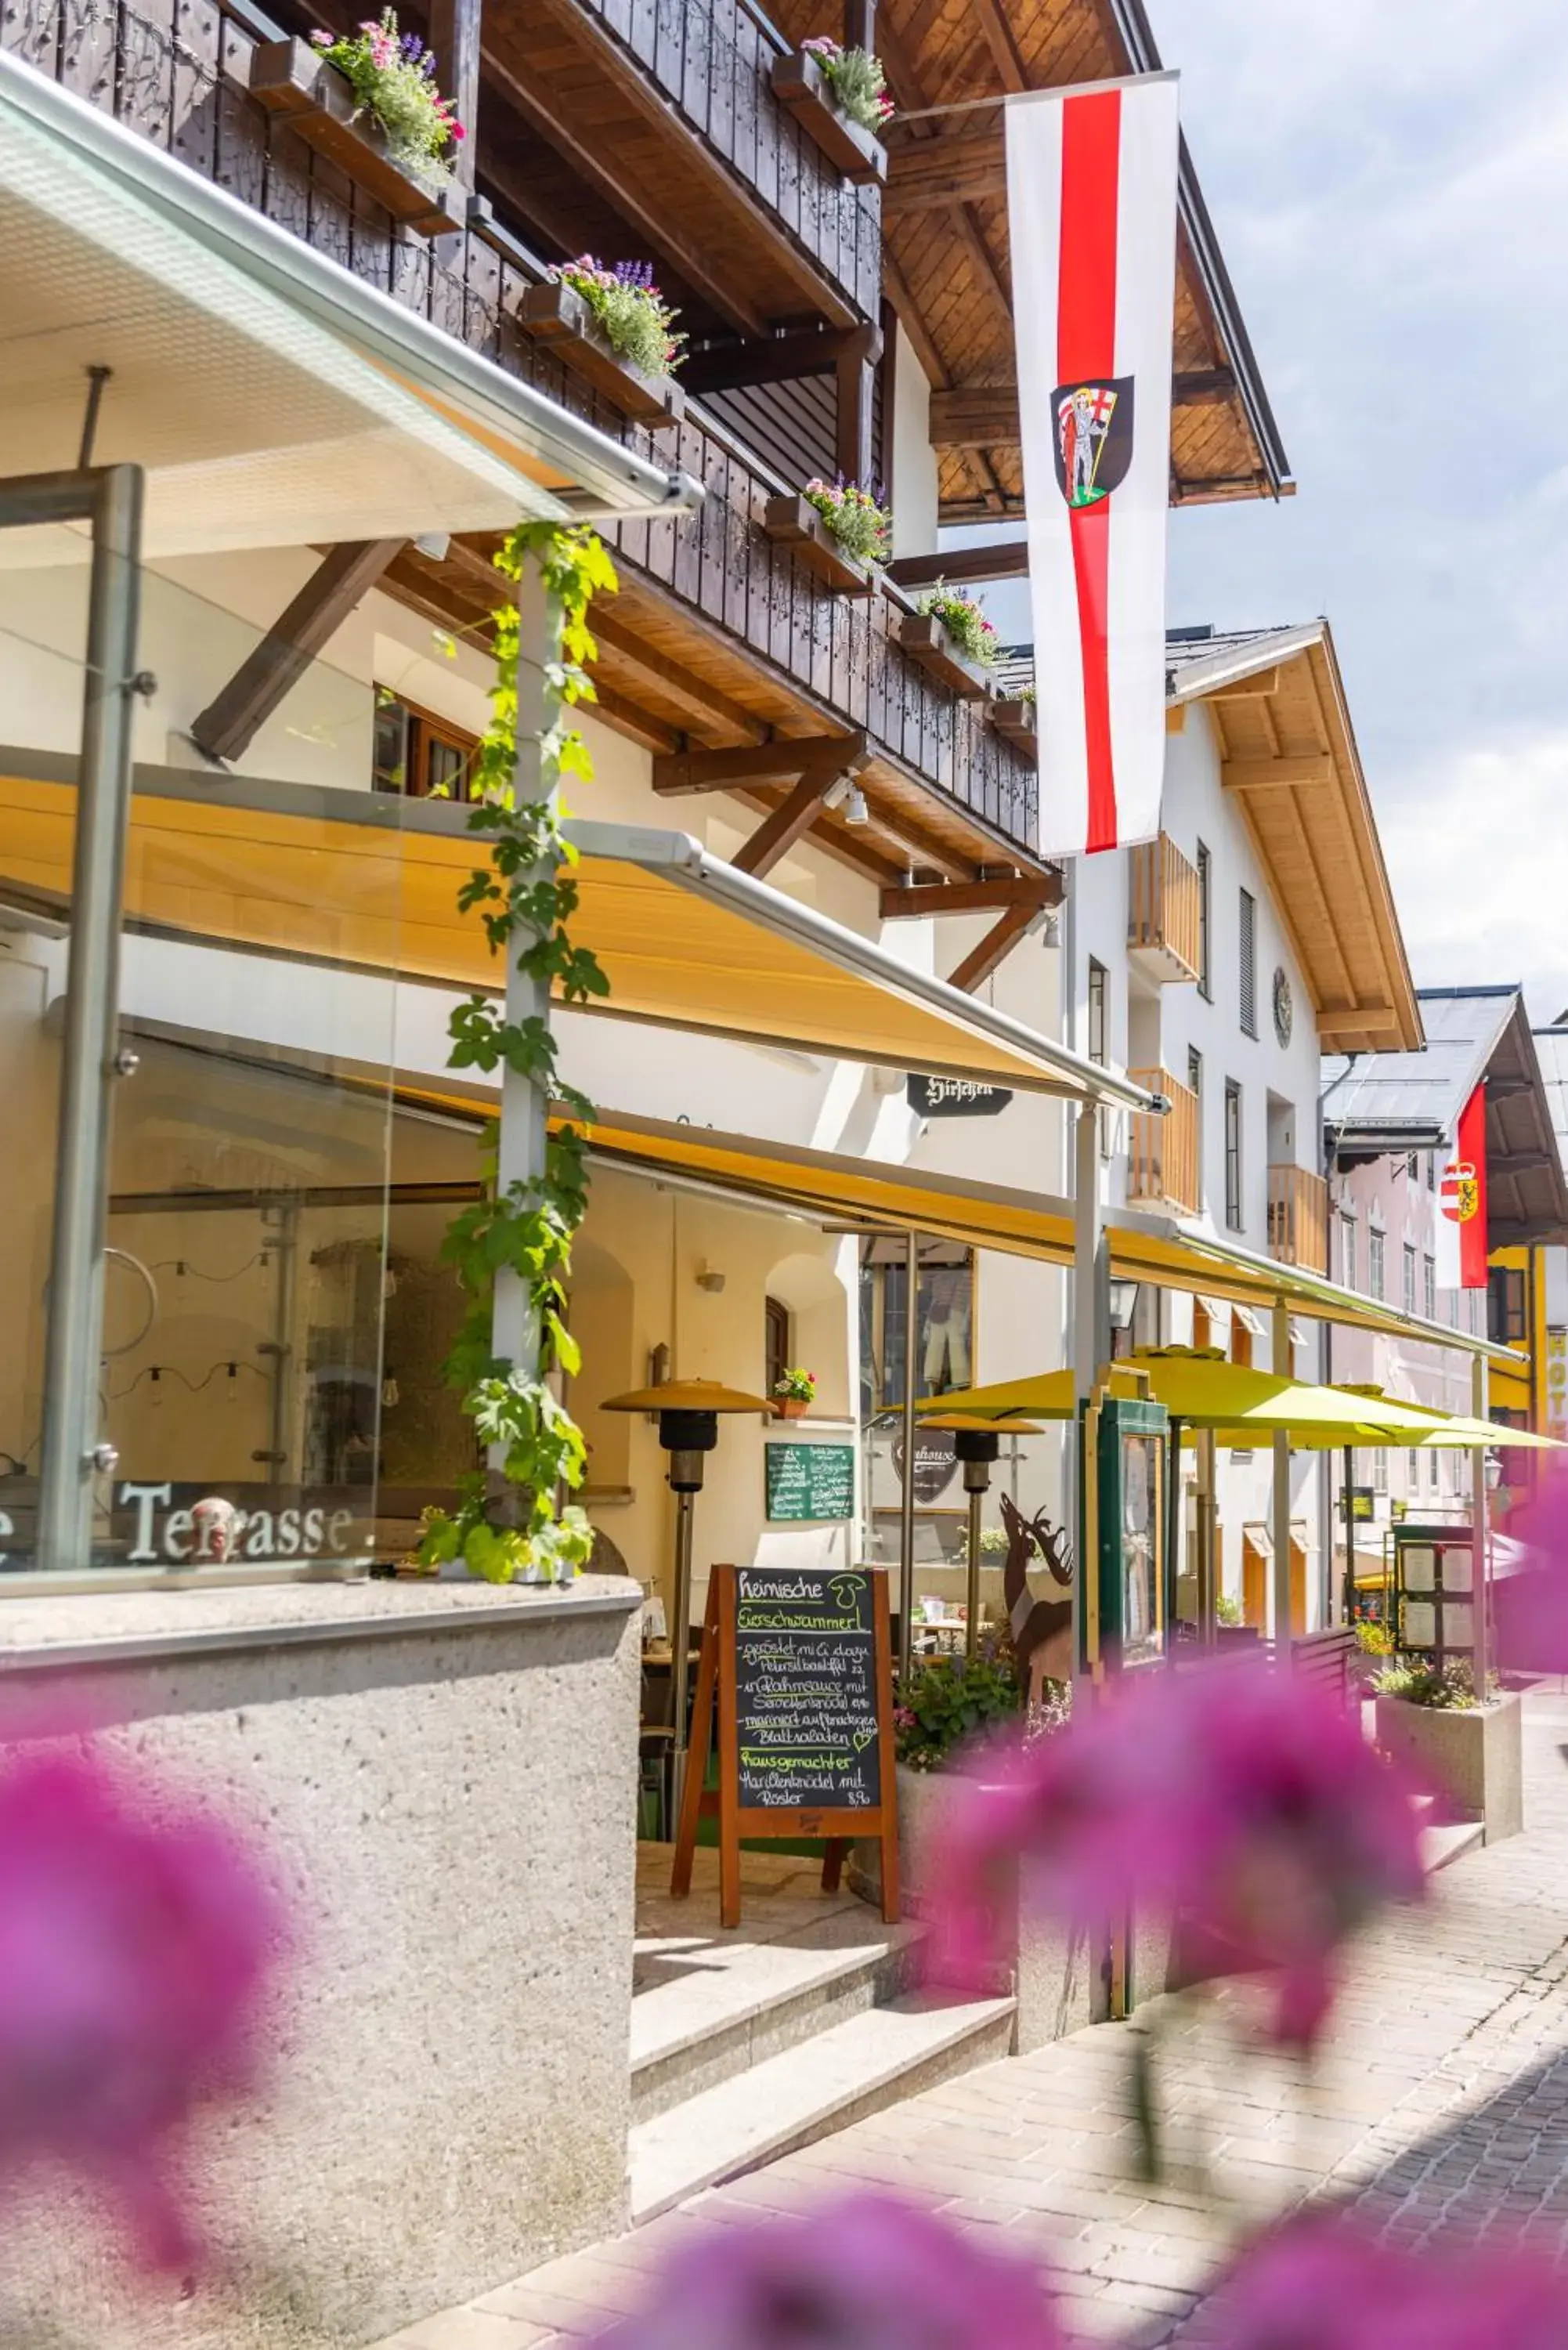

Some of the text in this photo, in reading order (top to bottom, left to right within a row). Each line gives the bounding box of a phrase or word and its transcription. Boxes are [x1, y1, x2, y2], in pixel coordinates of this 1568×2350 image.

[119, 1481, 352, 1560] Terrasse
[739, 1571, 824, 1599] heimische
[839, 1766, 865, 1789] mit
